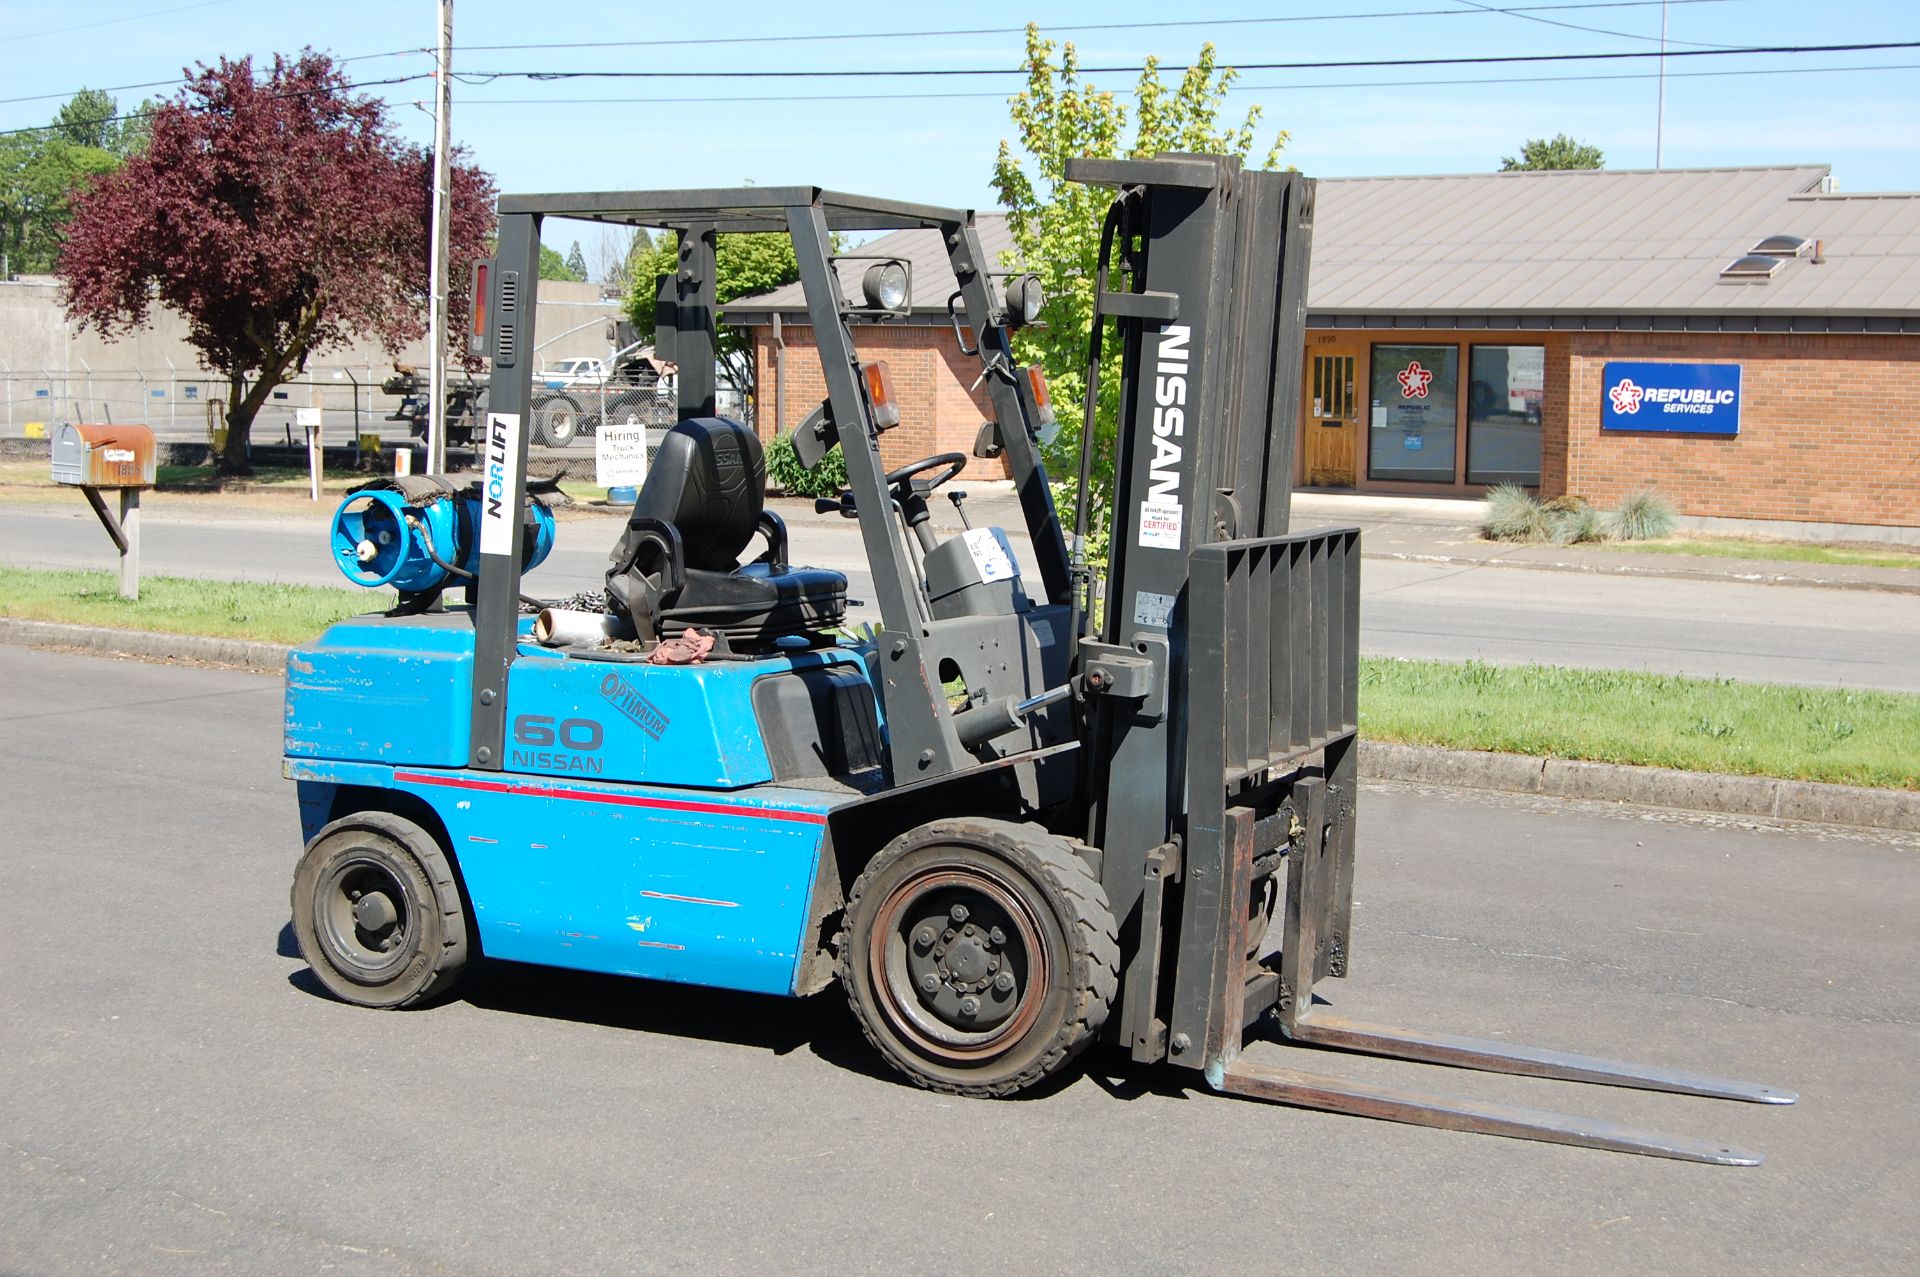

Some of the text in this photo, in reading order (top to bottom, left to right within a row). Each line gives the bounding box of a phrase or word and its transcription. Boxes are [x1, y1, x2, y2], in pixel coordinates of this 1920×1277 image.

[1644, 388, 1735, 404] REPUBLIC
[1148, 325, 1192, 504] NISSAN
[1663, 403, 1714, 414] SERVICES
[604, 431, 639, 442] Hiring
[487, 417, 507, 519] NORLIFT
[601, 452, 644, 461] Mechanics
[600, 672, 667, 735] OPTIMUM
[513, 714, 604, 751] 60
[512, 750, 604, 774] NISSAN
